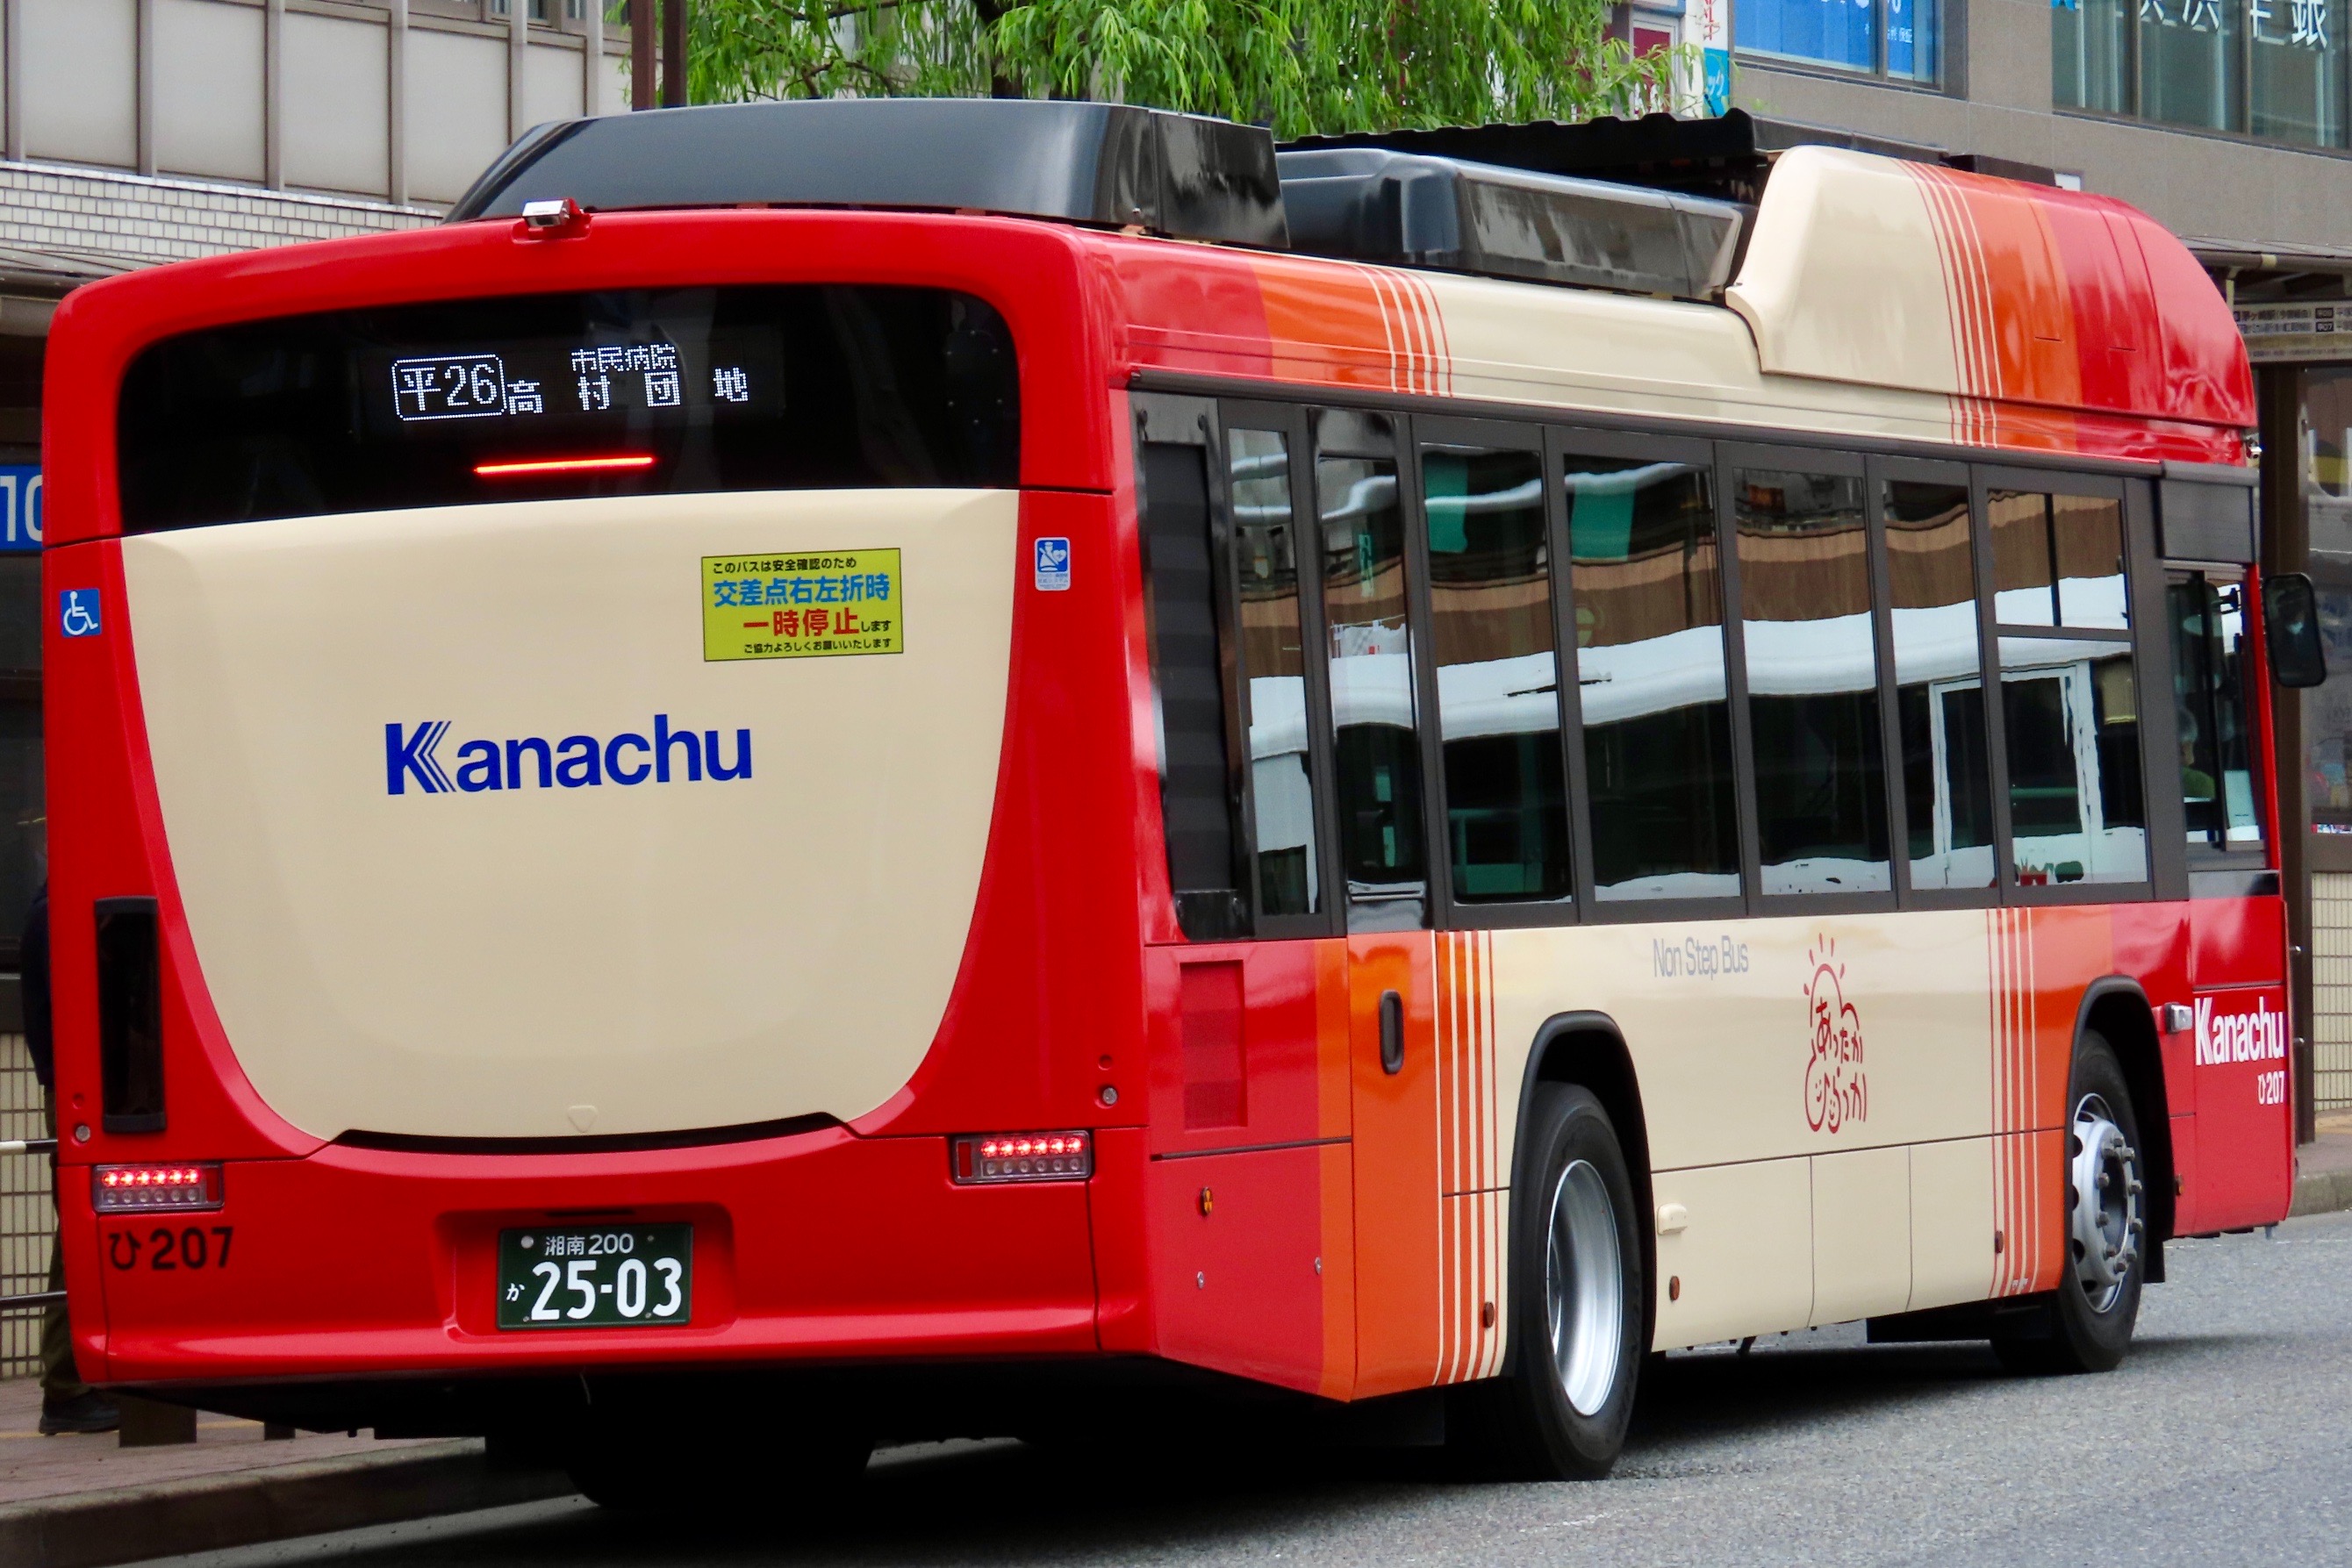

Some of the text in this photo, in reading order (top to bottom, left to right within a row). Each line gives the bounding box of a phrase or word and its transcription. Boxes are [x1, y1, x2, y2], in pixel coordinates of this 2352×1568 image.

[571, 344, 676, 374] 市民病院
[399, 364, 498, 412] 平26
[713, 557, 857, 574] このバスは安全確認のため
[713, 573, 890, 607] 交差点右左折時
[744, 638, 892, 655] ご協力よろしくお願いいたします
[385, 713, 752, 795] Kanachu
[1653, 934, 1749, 980] Non Step Bus
[2194, 996, 2285, 1066] Kanachu
[108, 1226, 233, 1271] ひ207
[506, 1257, 683, 1321] か 25-03
